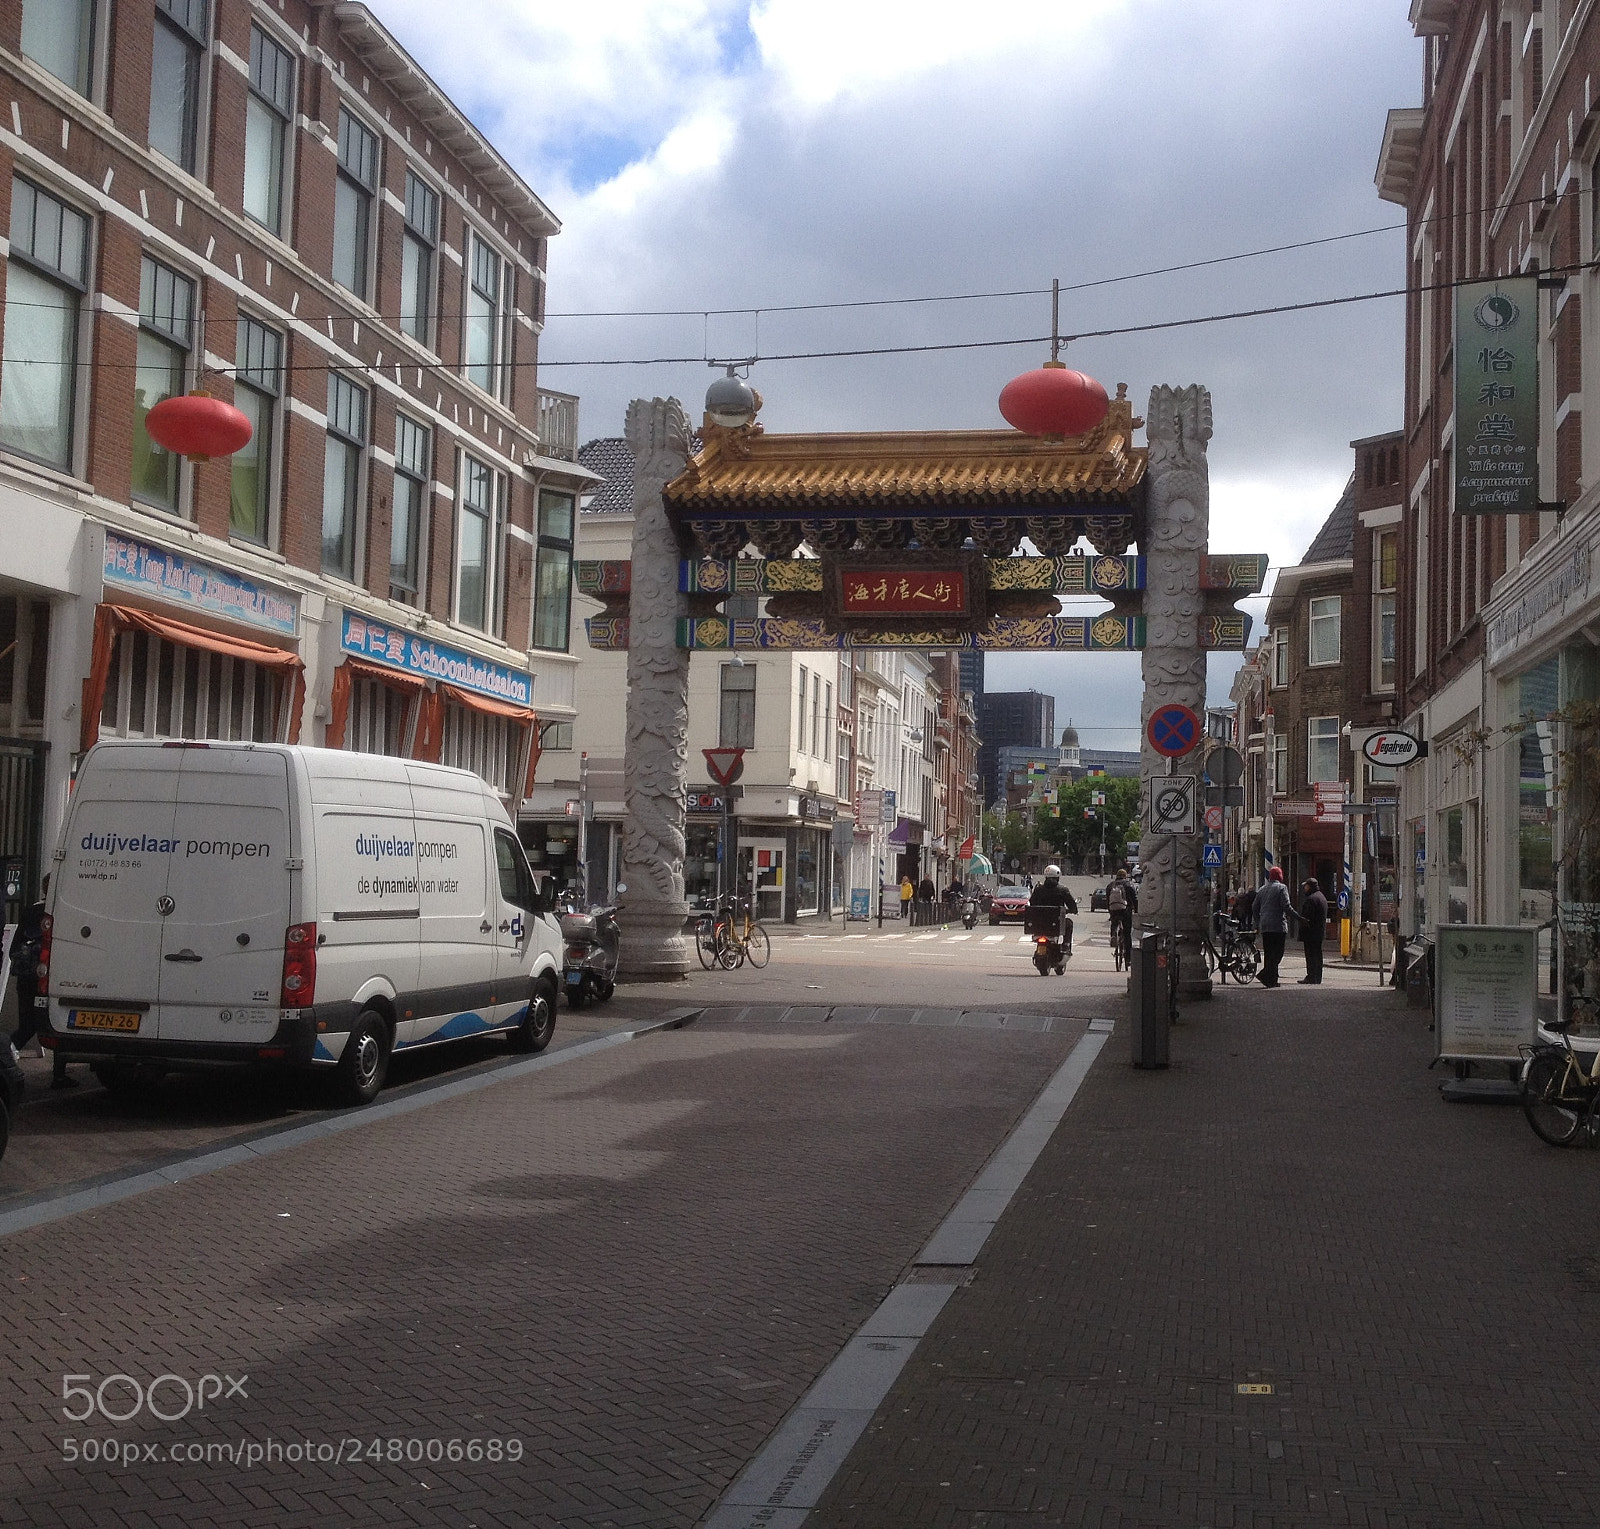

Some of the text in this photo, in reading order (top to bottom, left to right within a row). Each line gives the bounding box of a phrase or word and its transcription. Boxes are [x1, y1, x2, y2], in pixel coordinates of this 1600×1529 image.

[1475, 348, 1517, 441] 怡和堂
[1469, 489, 1520, 506] praktijk
[139, 546, 164, 591] Tong
[849, 578, 951, 602] 海牙唐人街
[345, 615, 406, 664] 同仁堂
[410, 638, 526, 702] Schoonheidsalon
[1370, 736, 1413, 755] Segafredo
[1161, 799, 1183, 812] 30
[80, 833, 271, 860] duijvelaar pompen
[355, 833, 458, 863] duijvelaar pompen
[109, 860, 119, 868] 48
[120, 860, 131, 869] 83
[131, 860, 142, 869] 66
[78, 872, 118, 882] www.dp.nl
[357, 876, 459, 898] de dynamiek van water
[79, 1013, 134, 1028] 3-VZN-26
